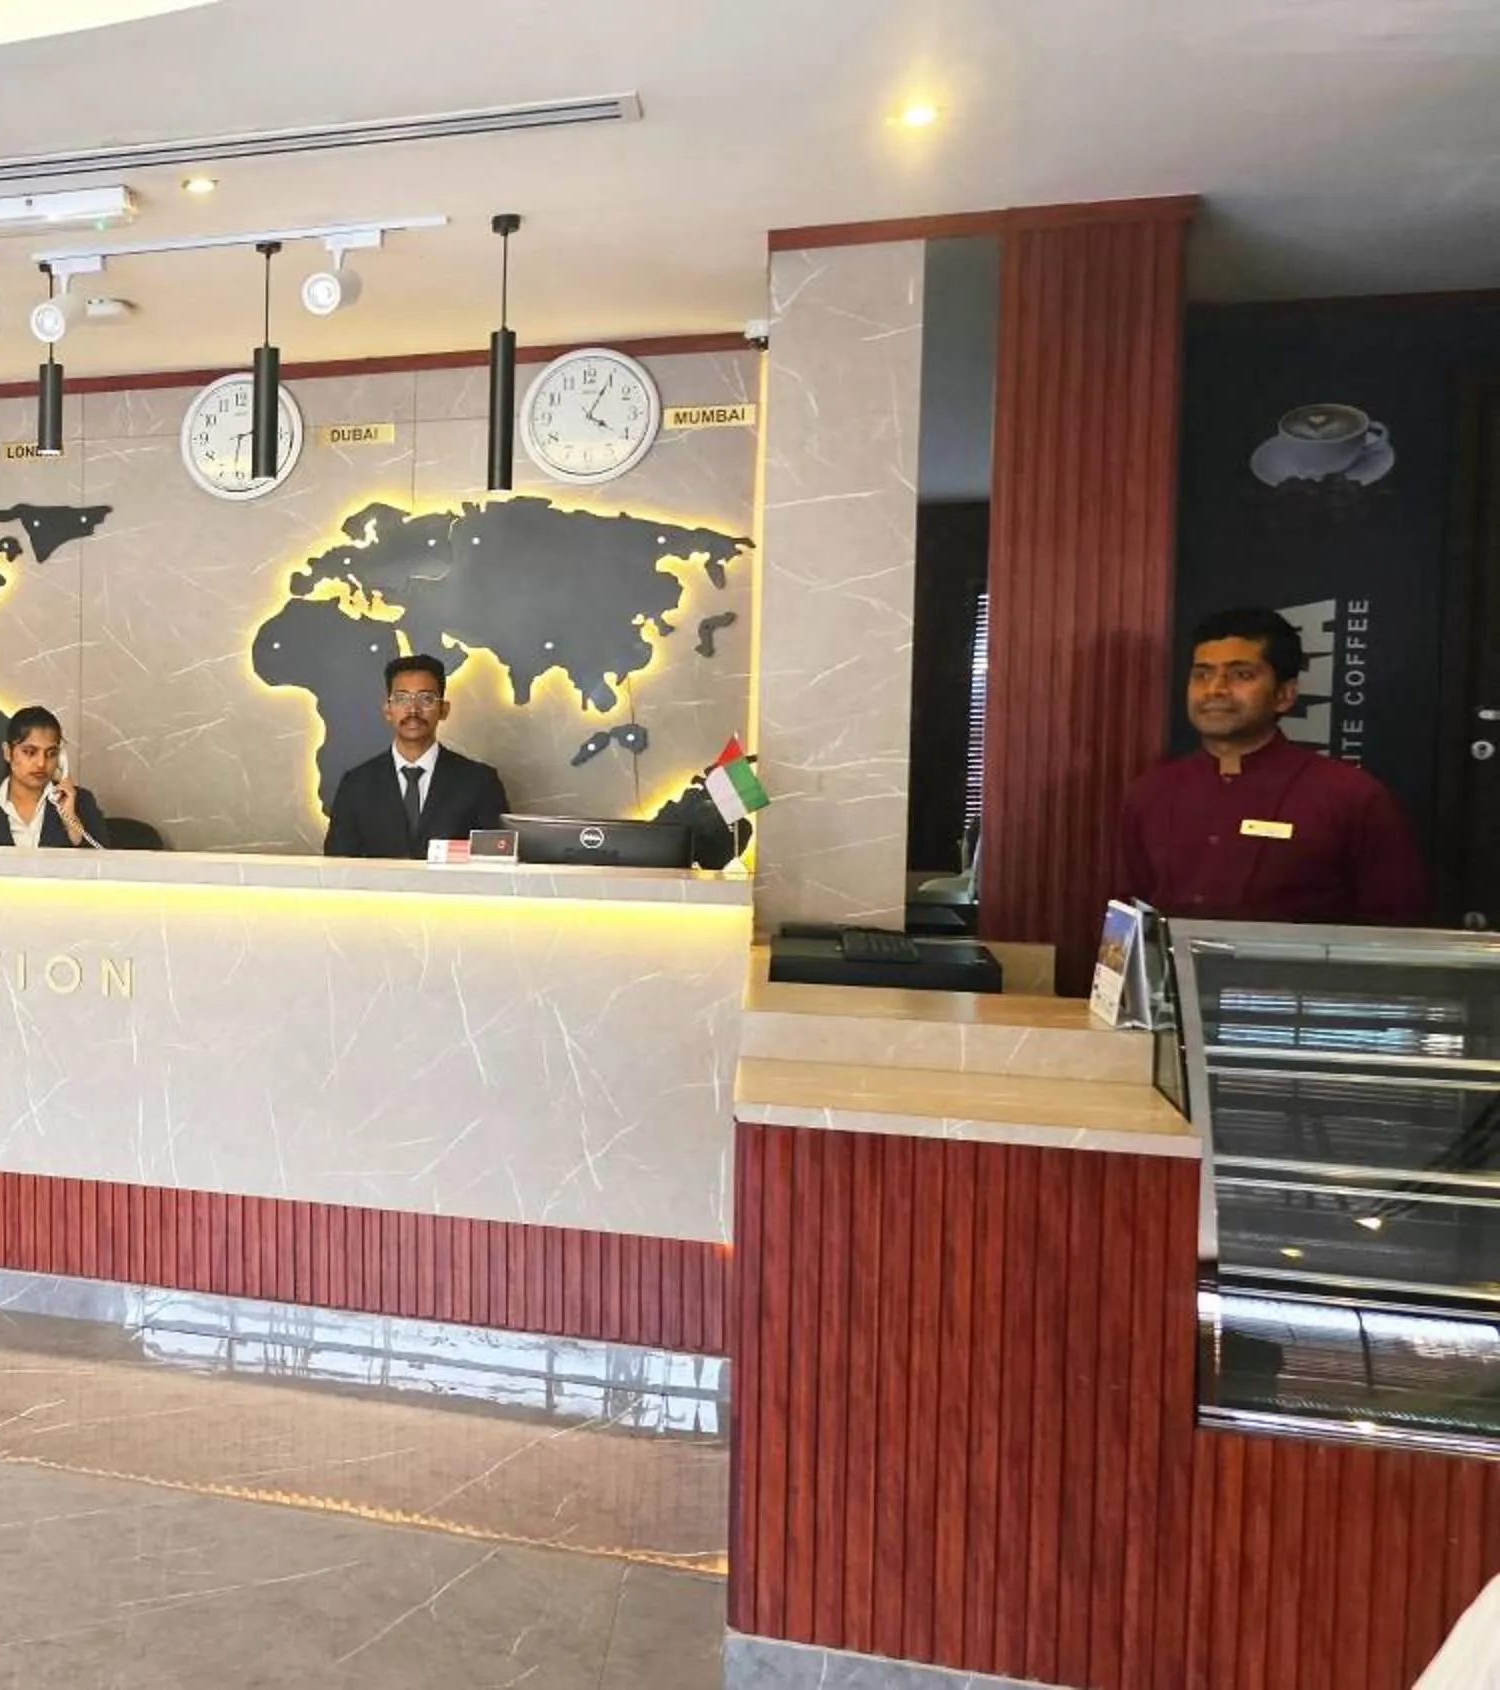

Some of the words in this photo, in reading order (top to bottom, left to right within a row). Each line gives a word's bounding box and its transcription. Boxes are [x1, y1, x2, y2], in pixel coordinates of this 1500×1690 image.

[564, 376, 575, 391] 11
[583, 368, 597, 385] 12
[235, 392, 247, 406] 12
[549, 391, 561, 406] 10
[621, 385, 631, 400] 2
[219, 399, 229, 412] 11
[626, 404, 638, 420] 3
[205, 413, 217, 427] 10
[541, 411, 552, 426] 9
[673, 407, 745, 425] MUMBAI
[199, 432, 208, 445] 9
[331, 427, 378, 443] DUBAI
[547, 431, 559, 444] 8
[205, 450, 215, 461] 8
[563, 444, 574, 460] 7
[1344, 600, 1369, 706] COFFEE
